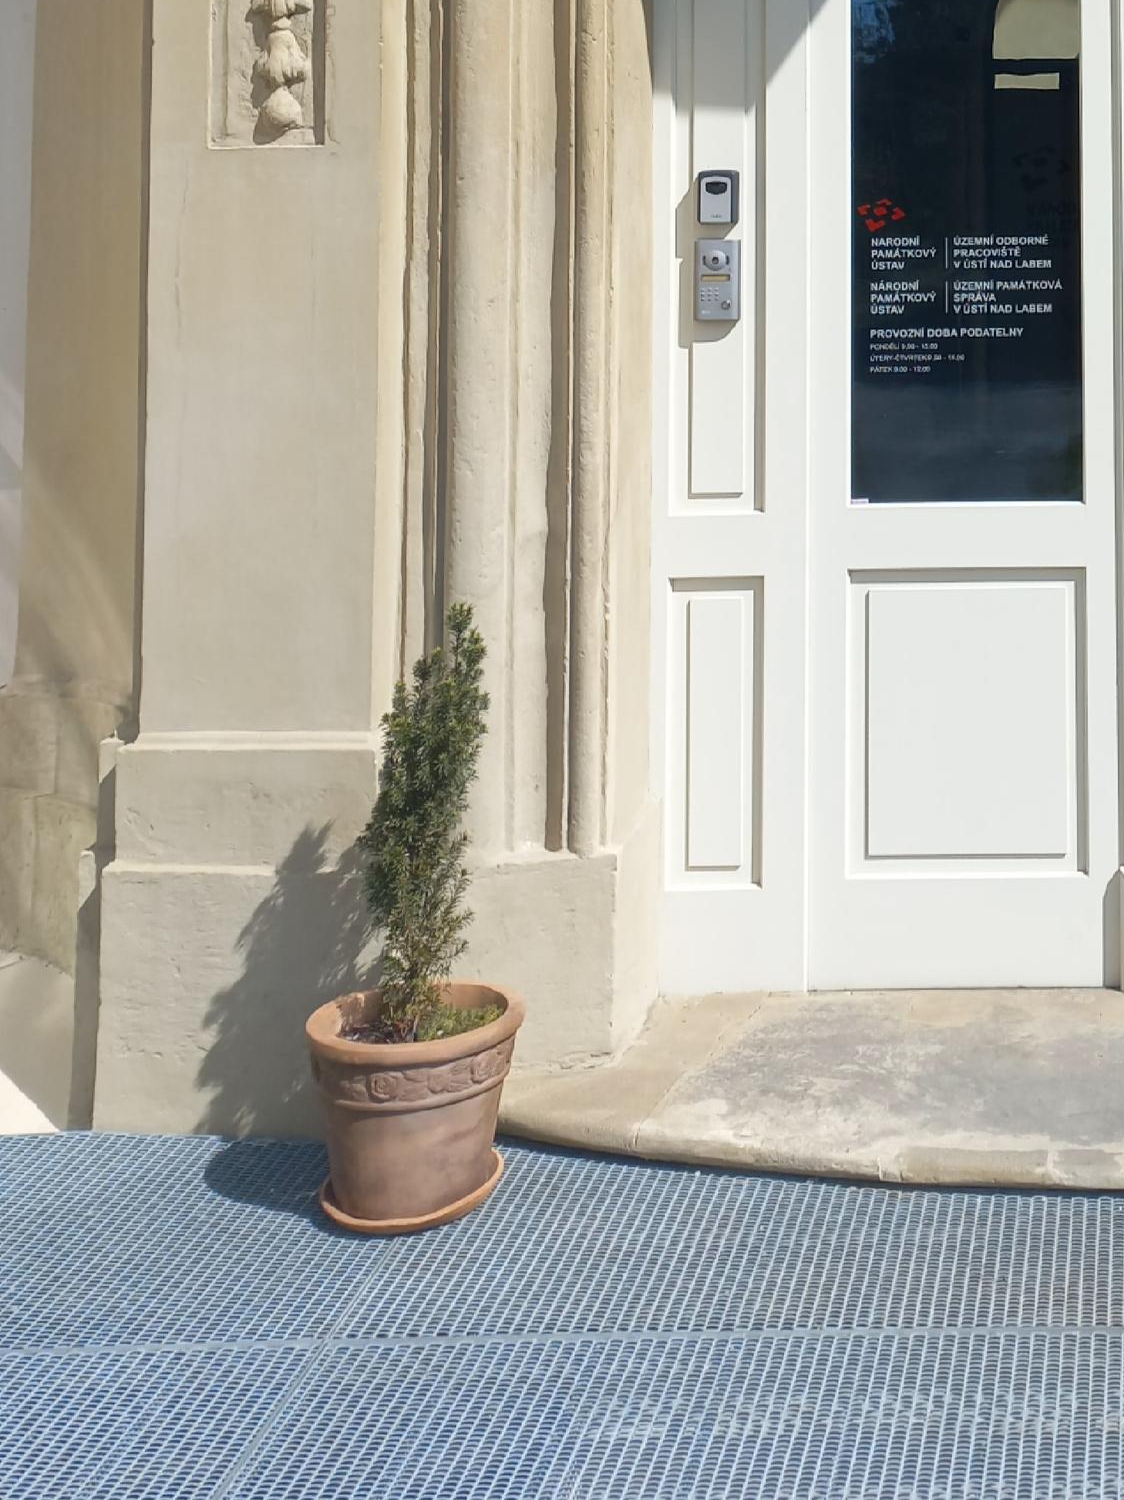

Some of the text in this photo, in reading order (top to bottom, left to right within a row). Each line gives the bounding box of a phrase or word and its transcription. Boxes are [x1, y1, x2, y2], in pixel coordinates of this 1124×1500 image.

[953, 233, 1049, 246] ÚZEMNÍ ODBORNÉ
[871, 247, 937, 258] PAMÁTKOVÝ
[953, 246, 1021, 257] PRACOVIŠTĚ
[871, 259, 905, 270] ÚSTAV
[953, 258, 1052, 269] V ÚSTÍ NAD LABEM
[870, 280, 920, 291] NÁRODNÍ
[953, 278, 1063, 291] ÚZEMNÍ PAMÁTKOVÁ
[870, 290, 937, 303] PAMÁTKOVÝ
[953, 291, 997, 302] SPRÁVA
[870, 303, 905, 314] ÚSTAV
[953, 302, 1053, 314] V ÚSTÍ NAD LABEM
[869, 327, 1024, 338] PROVOZNÍ DOBA PODATELNY
